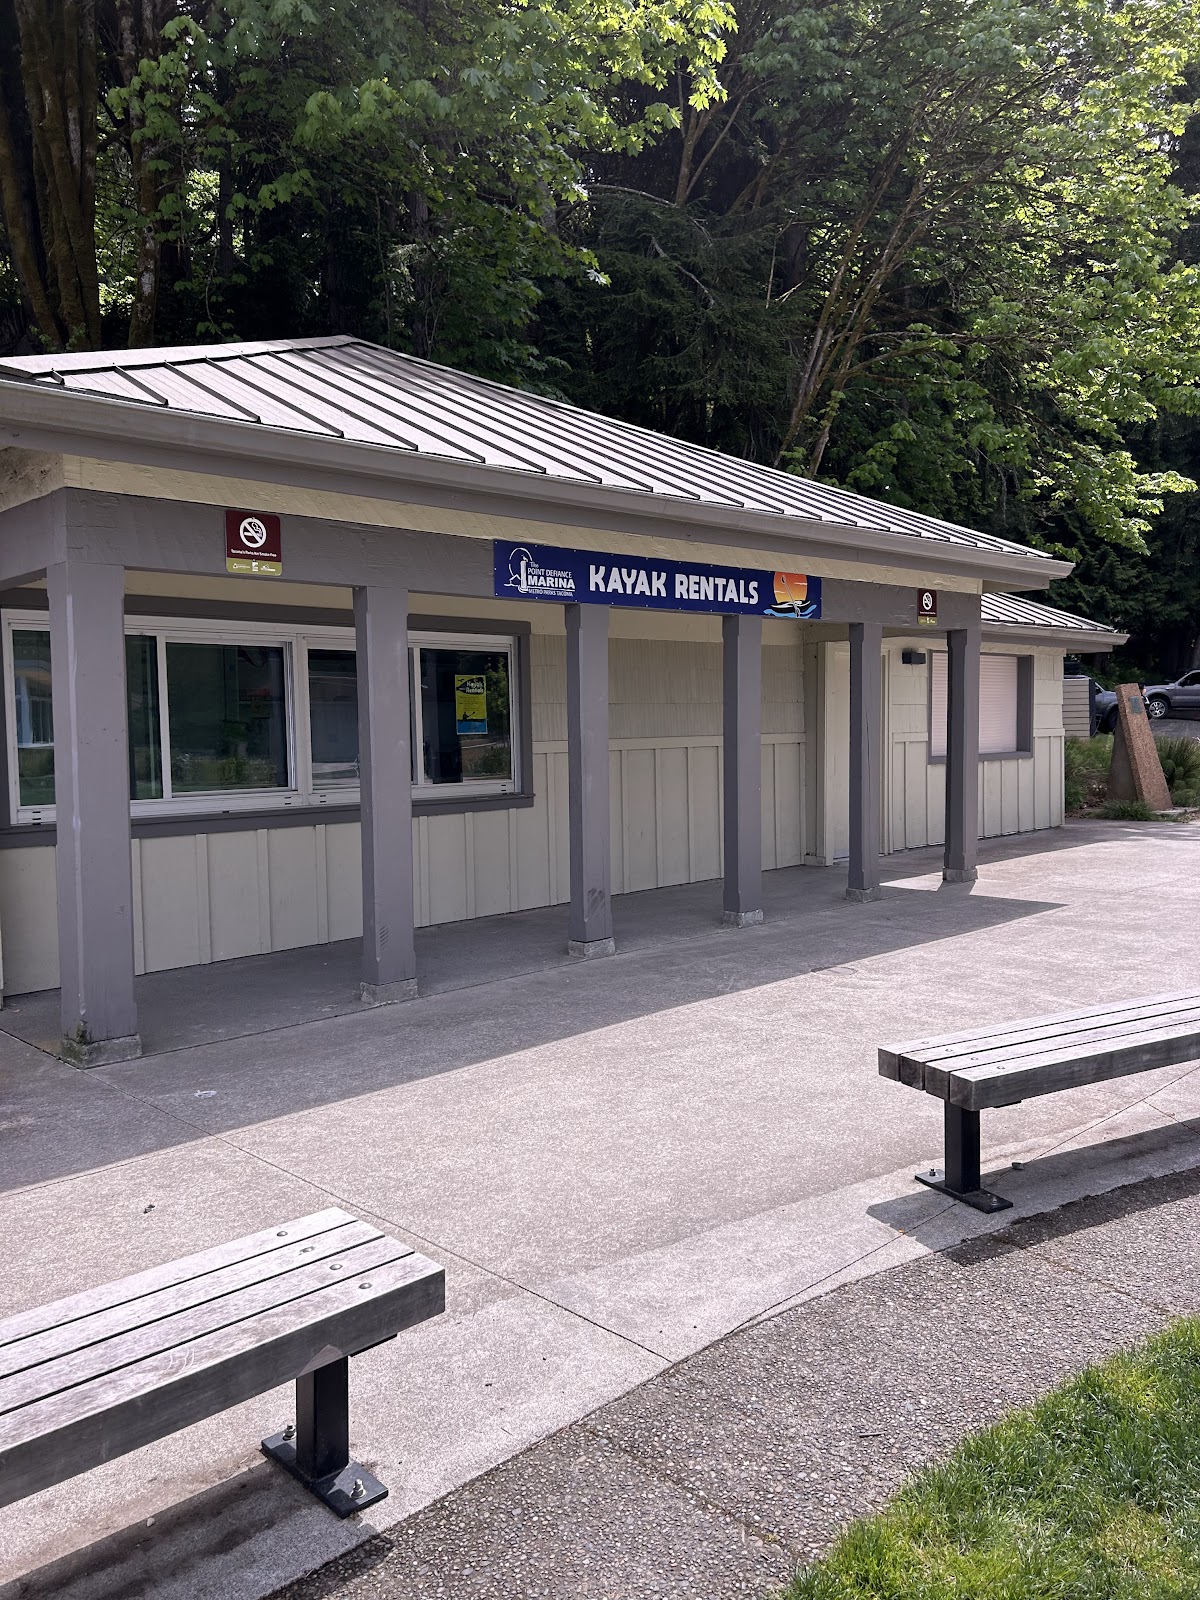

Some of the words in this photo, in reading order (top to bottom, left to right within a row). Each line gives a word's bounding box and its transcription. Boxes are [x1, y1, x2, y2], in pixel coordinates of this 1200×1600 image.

[546, 569, 572, 578] DEFIANCE
[528, 575, 575, 589] MARINA
[589, 565, 667, 597] KAYAK
[675, 573, 759, 604] RENTALS
